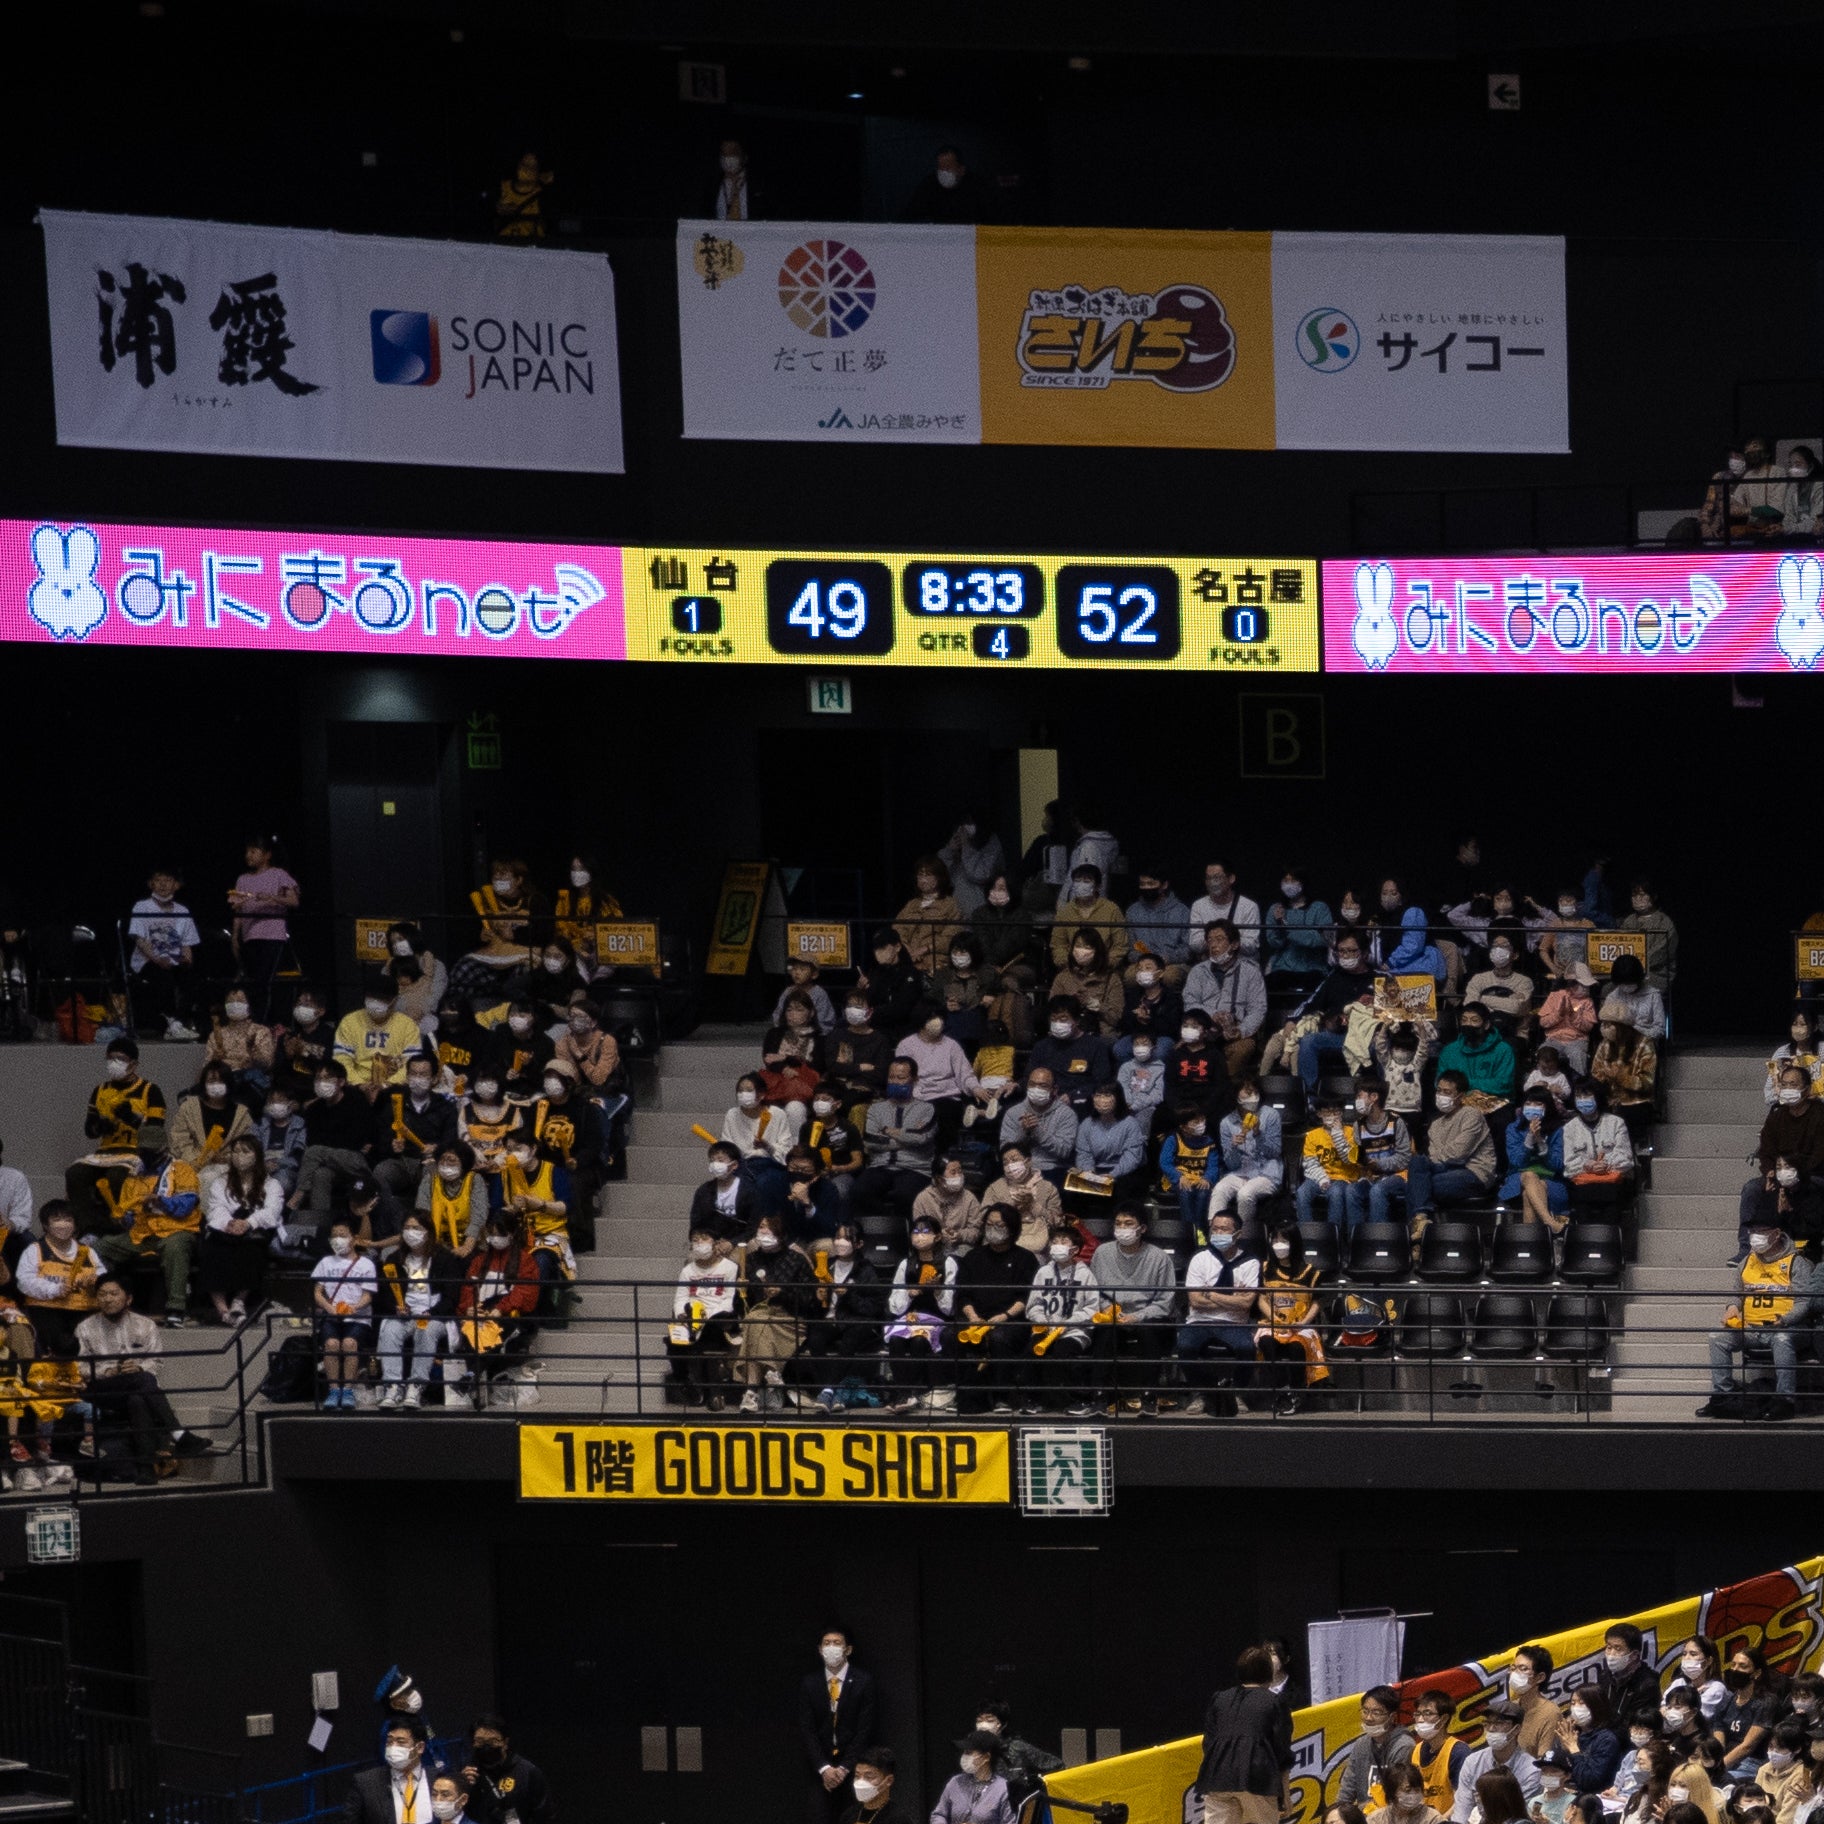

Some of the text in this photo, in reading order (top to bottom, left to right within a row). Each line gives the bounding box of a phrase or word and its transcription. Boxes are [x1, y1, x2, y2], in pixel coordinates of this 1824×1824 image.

[449, 316, 589, 358] SONIC
[1026, 313, 1193, 376] さいち
[1376, 331, 1547, 374] サイコー
[465, 354, 595, 399] JAPAN
[773, 346, 888, 373] だて正夢
[1025, 375, 1107, 388] SINCE 1971
[857, 413, 966, 430] JA全農みやぎ
[118, 547, 570, 639] みにまるnet
[648, 555, 739, 593] 仙台
[920, 569, 1026, 616] 8:33
[1193, 567, 1306, 604] 名古屋
[683, 599, 700, 633] 1
[788, 580, 868, 640] 49
[1079, 587, 1159, 644] 52
[1236, 610, 1255, 643] 0
[1405, 573, 1704, 654] みにまるnet
[918, 632, 968, 652] QTR
[990, 627, 1010, 660] 4
[553, 1430, 977, 1500] 1階 GOODS SHOP
